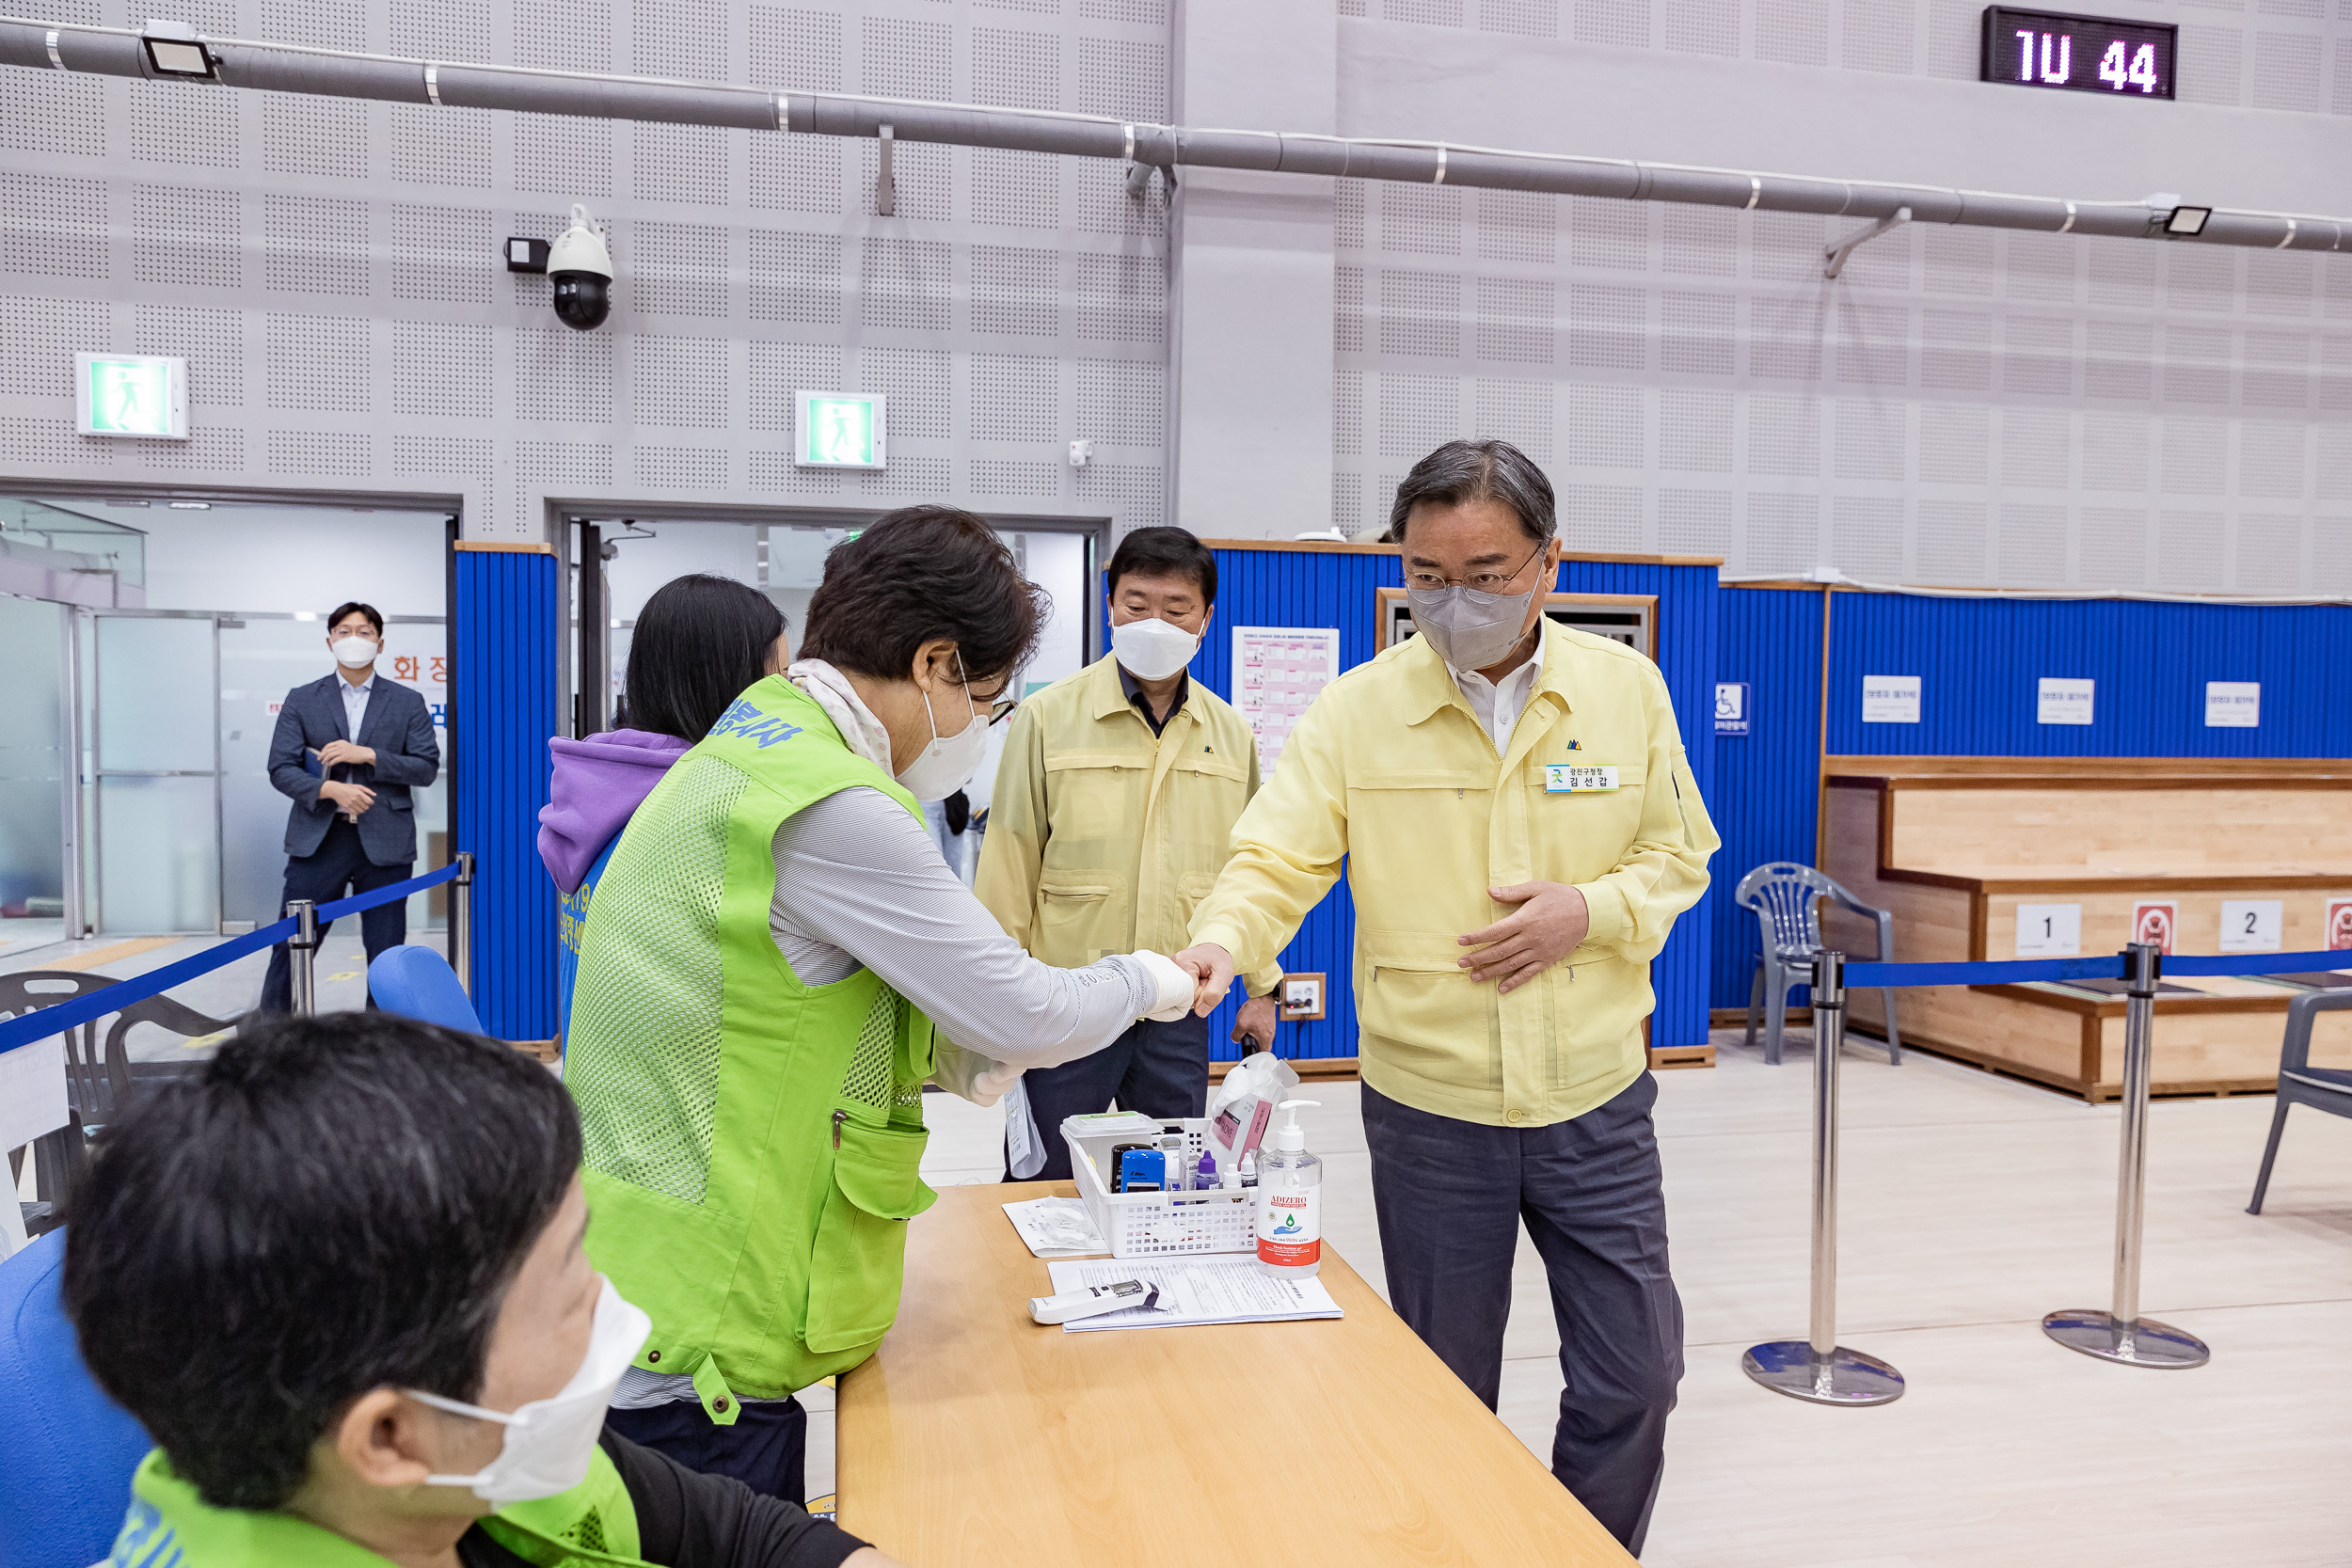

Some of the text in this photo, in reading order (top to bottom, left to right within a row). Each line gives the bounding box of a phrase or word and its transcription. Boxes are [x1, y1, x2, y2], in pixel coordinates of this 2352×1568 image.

[2098, 40, 2158, 93] 44
[1569, 768, 1603, 776] 광진구청장
[2043, 916, 2052, 939] 1
[2245, 911, 2257, 934] 2
[1271, 1196, 1307, 1205] ADIZERO
